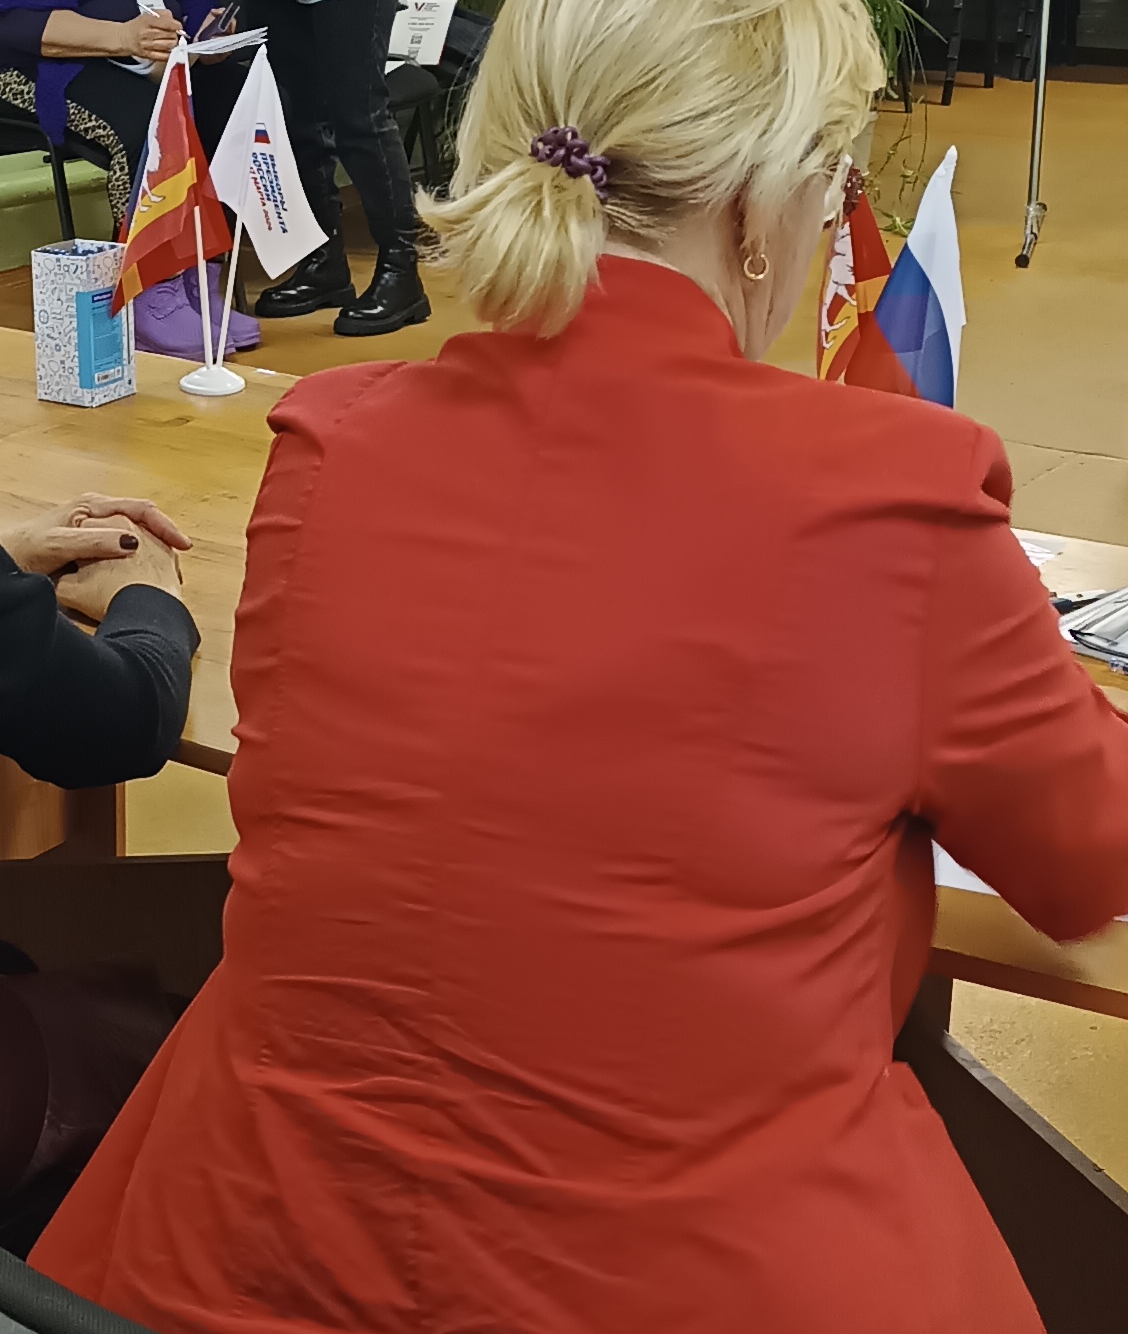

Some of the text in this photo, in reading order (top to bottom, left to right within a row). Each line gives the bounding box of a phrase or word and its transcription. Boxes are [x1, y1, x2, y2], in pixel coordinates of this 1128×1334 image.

[251, 176, 266, 211] МАРТА
[260, 152, 288, 233] ПРЕЗИДЕНТА
[268, 154, 288, 212] ВЫБОРЫ
